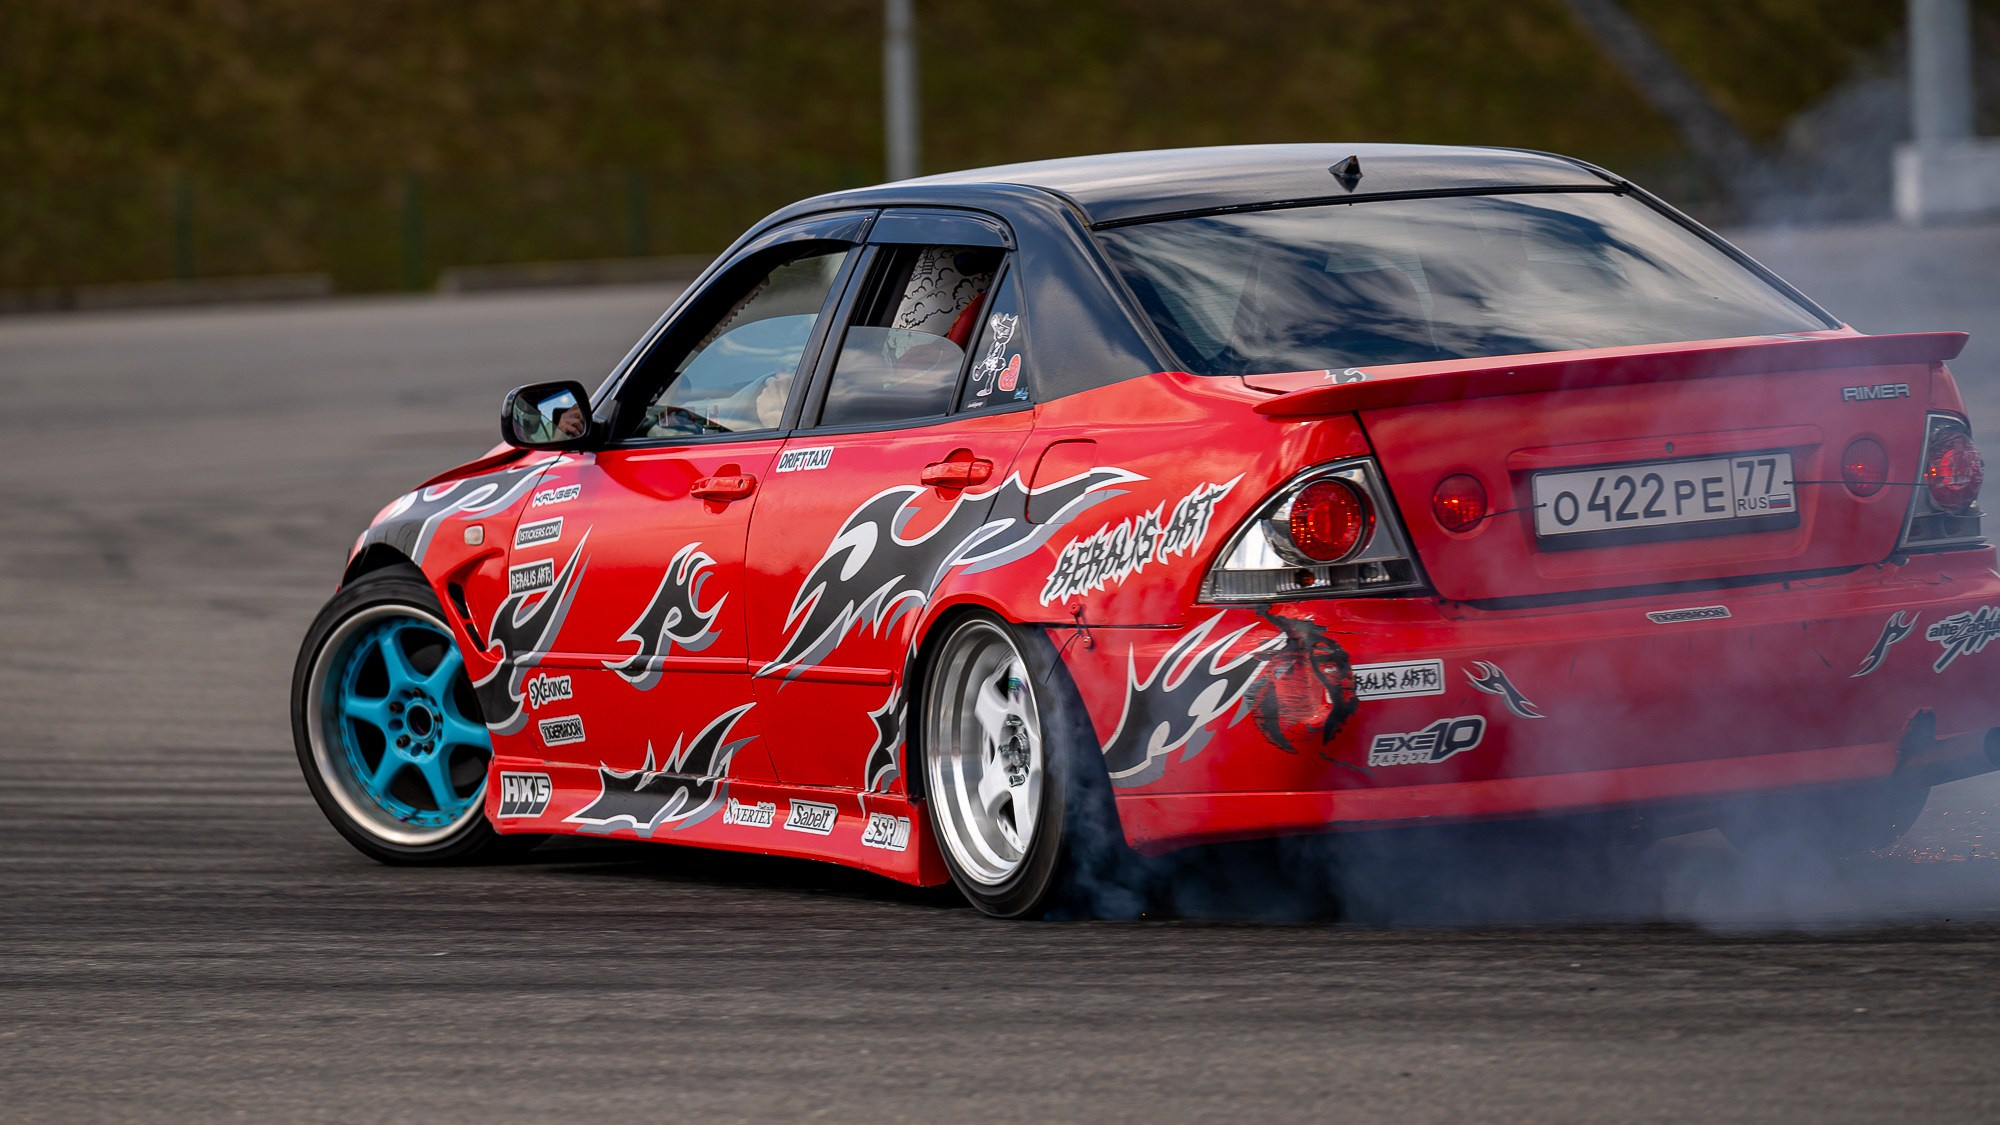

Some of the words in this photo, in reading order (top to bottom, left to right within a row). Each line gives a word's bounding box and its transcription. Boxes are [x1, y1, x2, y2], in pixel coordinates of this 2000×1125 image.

[1842, 382, 1911, 402] RIMER
[779, 452, 808, 469] DRIFT
[807, 449, 831, 466] TAXI
[1737, 458, 1776, 497] 77
[534, 486, 580, 503] KRUGER
[1737, 497, 1768, 511] RUS
[530, 677, 572, 706] SXEKINGZ
[1373, 718, 1482, 761] SXE10
[504, 777, 550, 803] HKS
[735, 807, 774, 825] VERTEX
[793, 804, 831, 829] Sabelt
